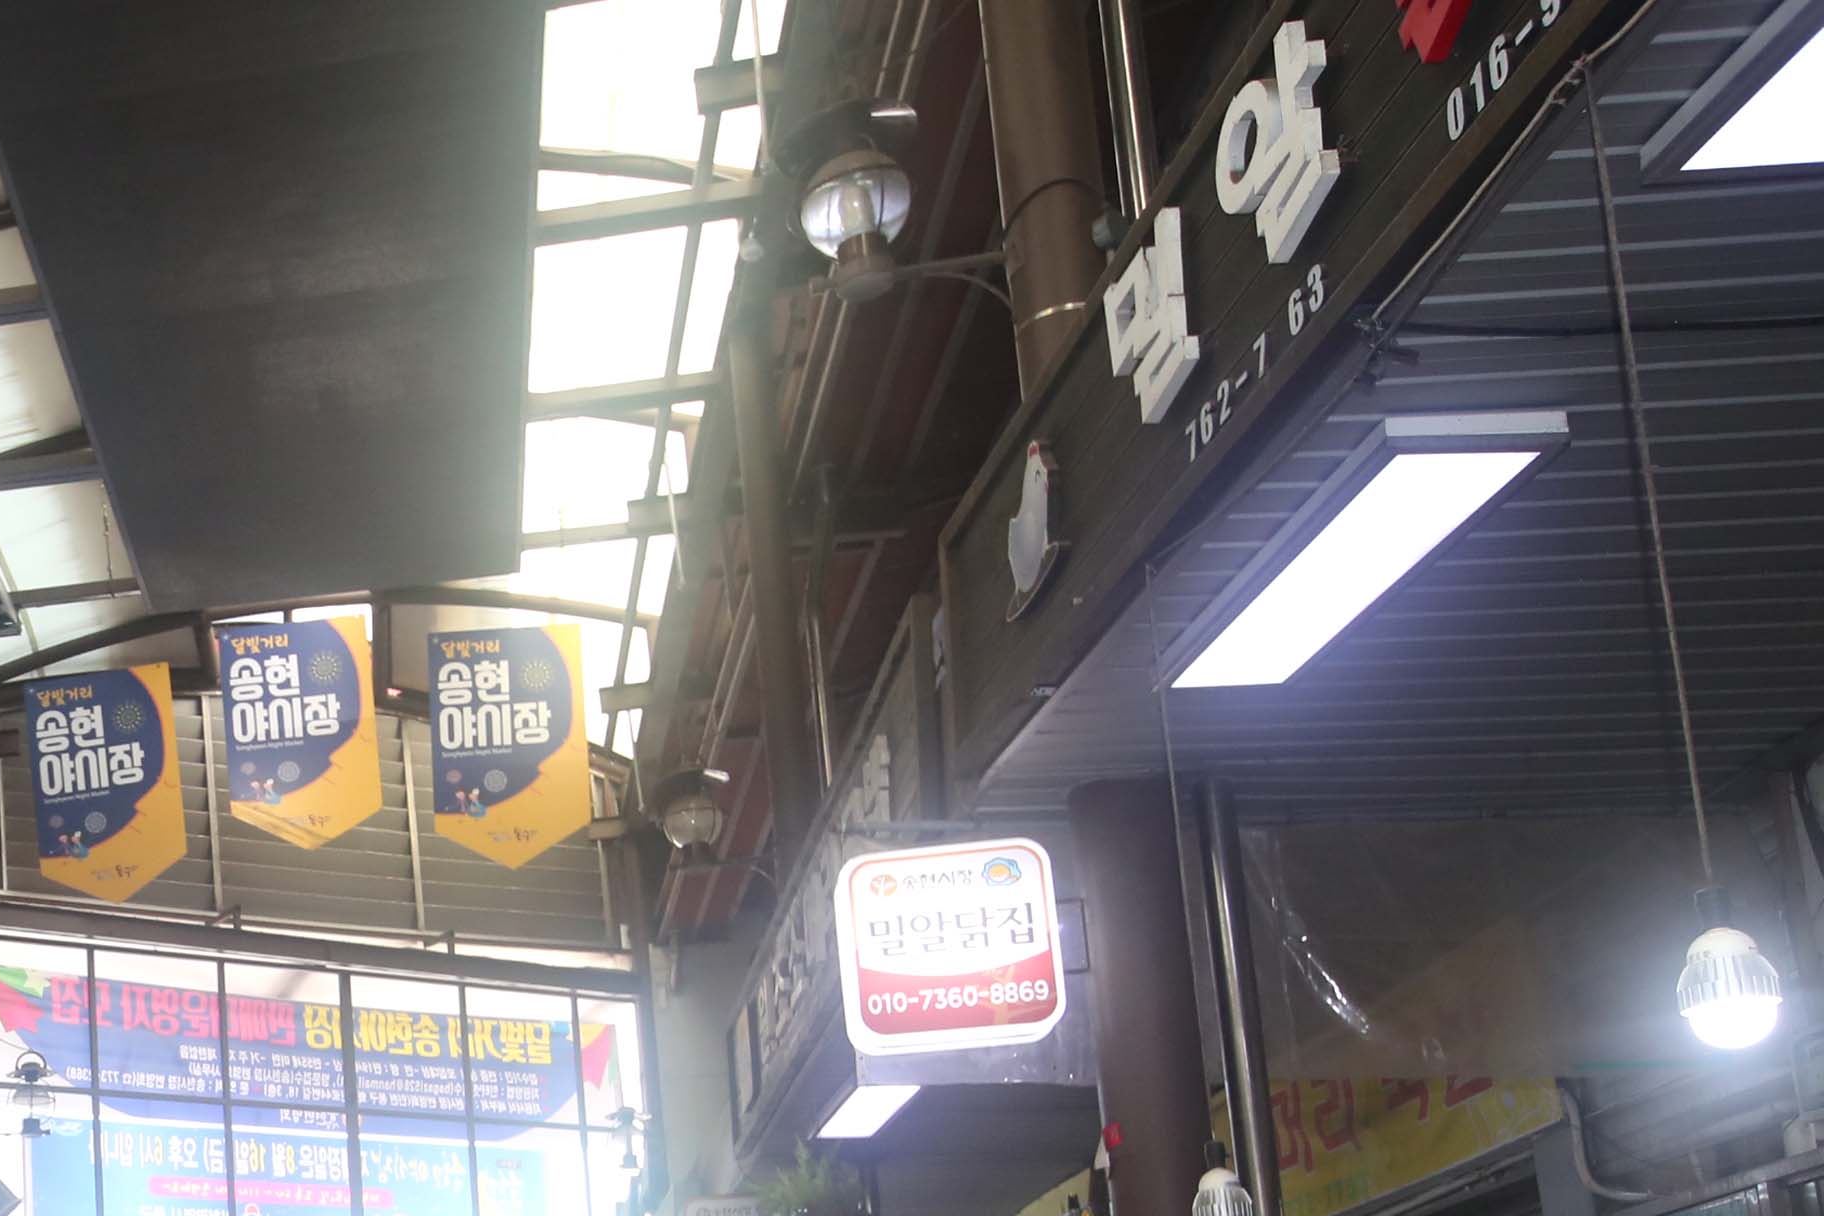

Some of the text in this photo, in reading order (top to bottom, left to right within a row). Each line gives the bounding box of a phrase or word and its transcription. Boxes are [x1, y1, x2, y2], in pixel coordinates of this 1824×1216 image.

[231, 633, 289, 655] 달빛거리
[440, 639, 501, 659] 달빛거리
[36, 685, 93, 707] 달빛거리
[230, 654, 300, 701] 송현
[438, 659, 511, 706] 송현
[35, 705, 105, 753] 송현
[232, 693, 341, 743] 야시장
[439, 701, 551, 750] 야시장
[39, 741, 145, 796] 야시장
[869, 902, 1035, 956] 밀알닭집
[867, 979, 1049, 1016] 010-7360-8869
